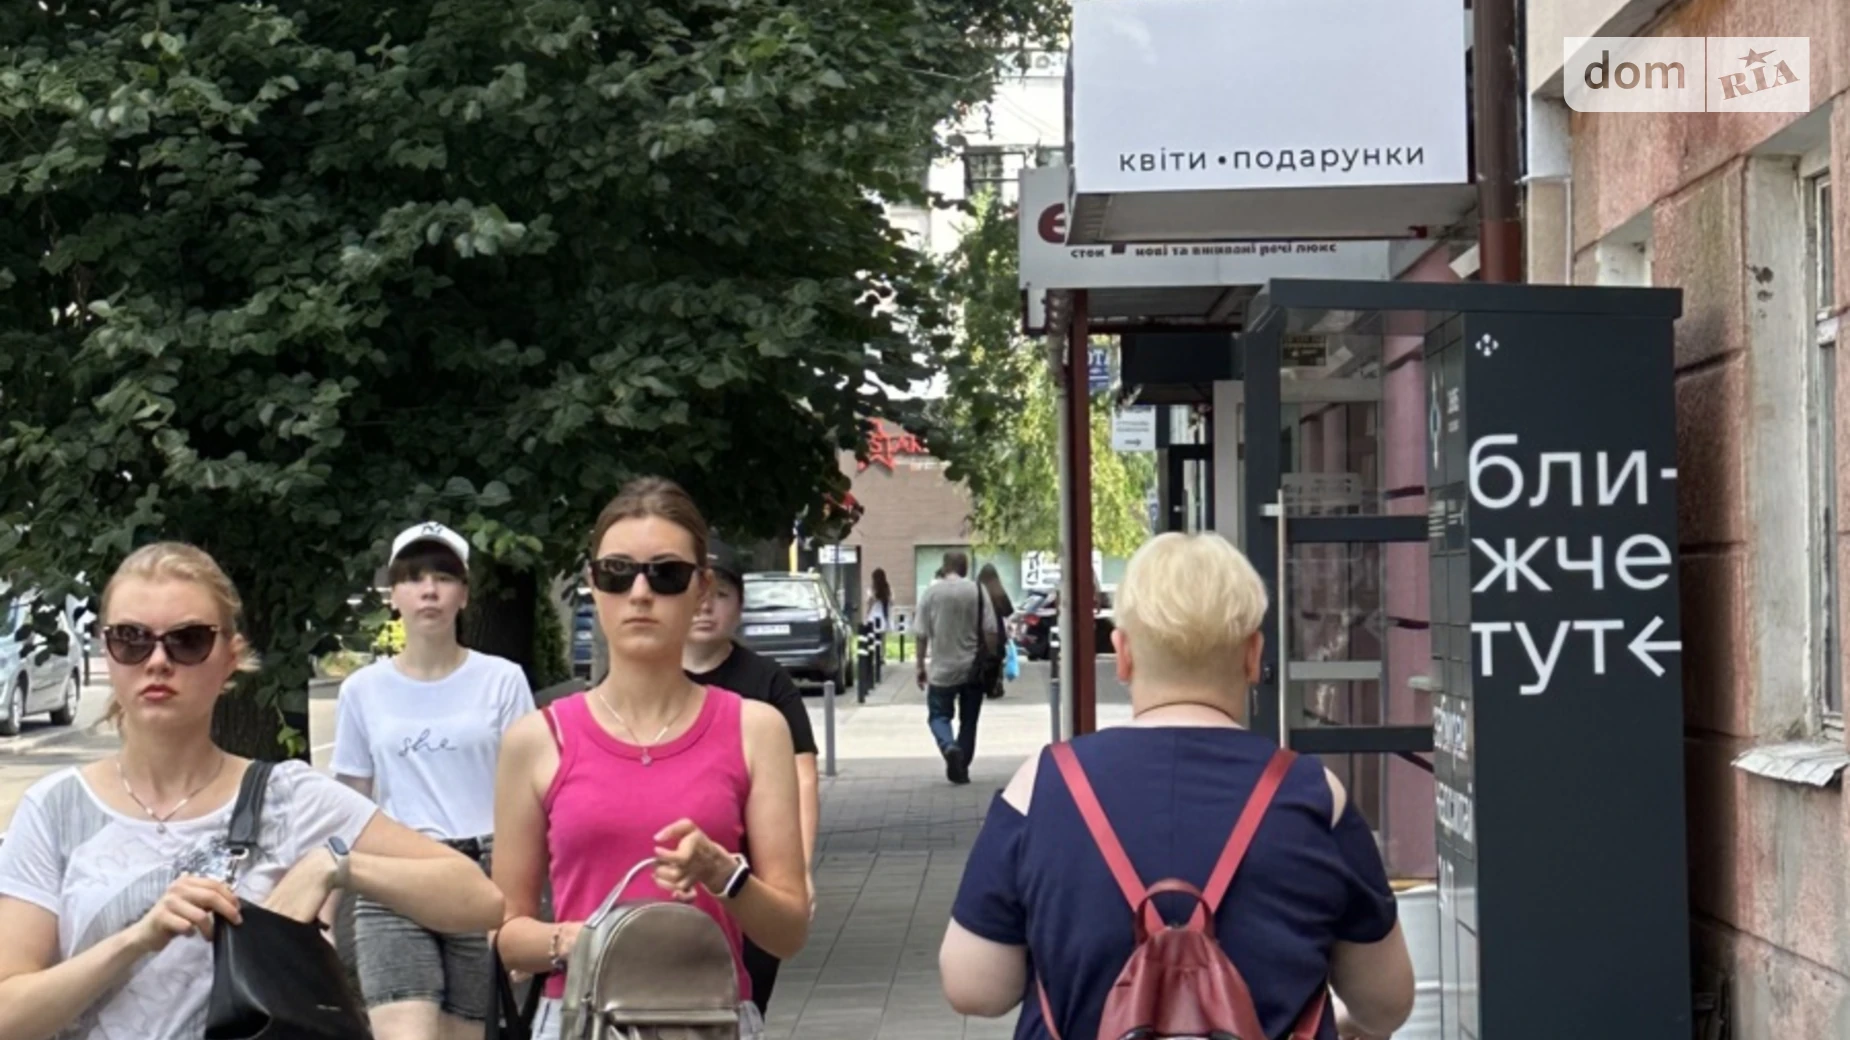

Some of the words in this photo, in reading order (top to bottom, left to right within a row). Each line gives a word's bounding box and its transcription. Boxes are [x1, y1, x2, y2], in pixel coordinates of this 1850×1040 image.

[1119, 146, 1206, 172] квіти
[1234, 144, 1425, 173] подарунки
[1468, 434, 1678, 509] бли-
[1470, 534, 1672, 593] жче
[1470, 620, 1625, 695] тут
[398, 728, 458, 757] she
